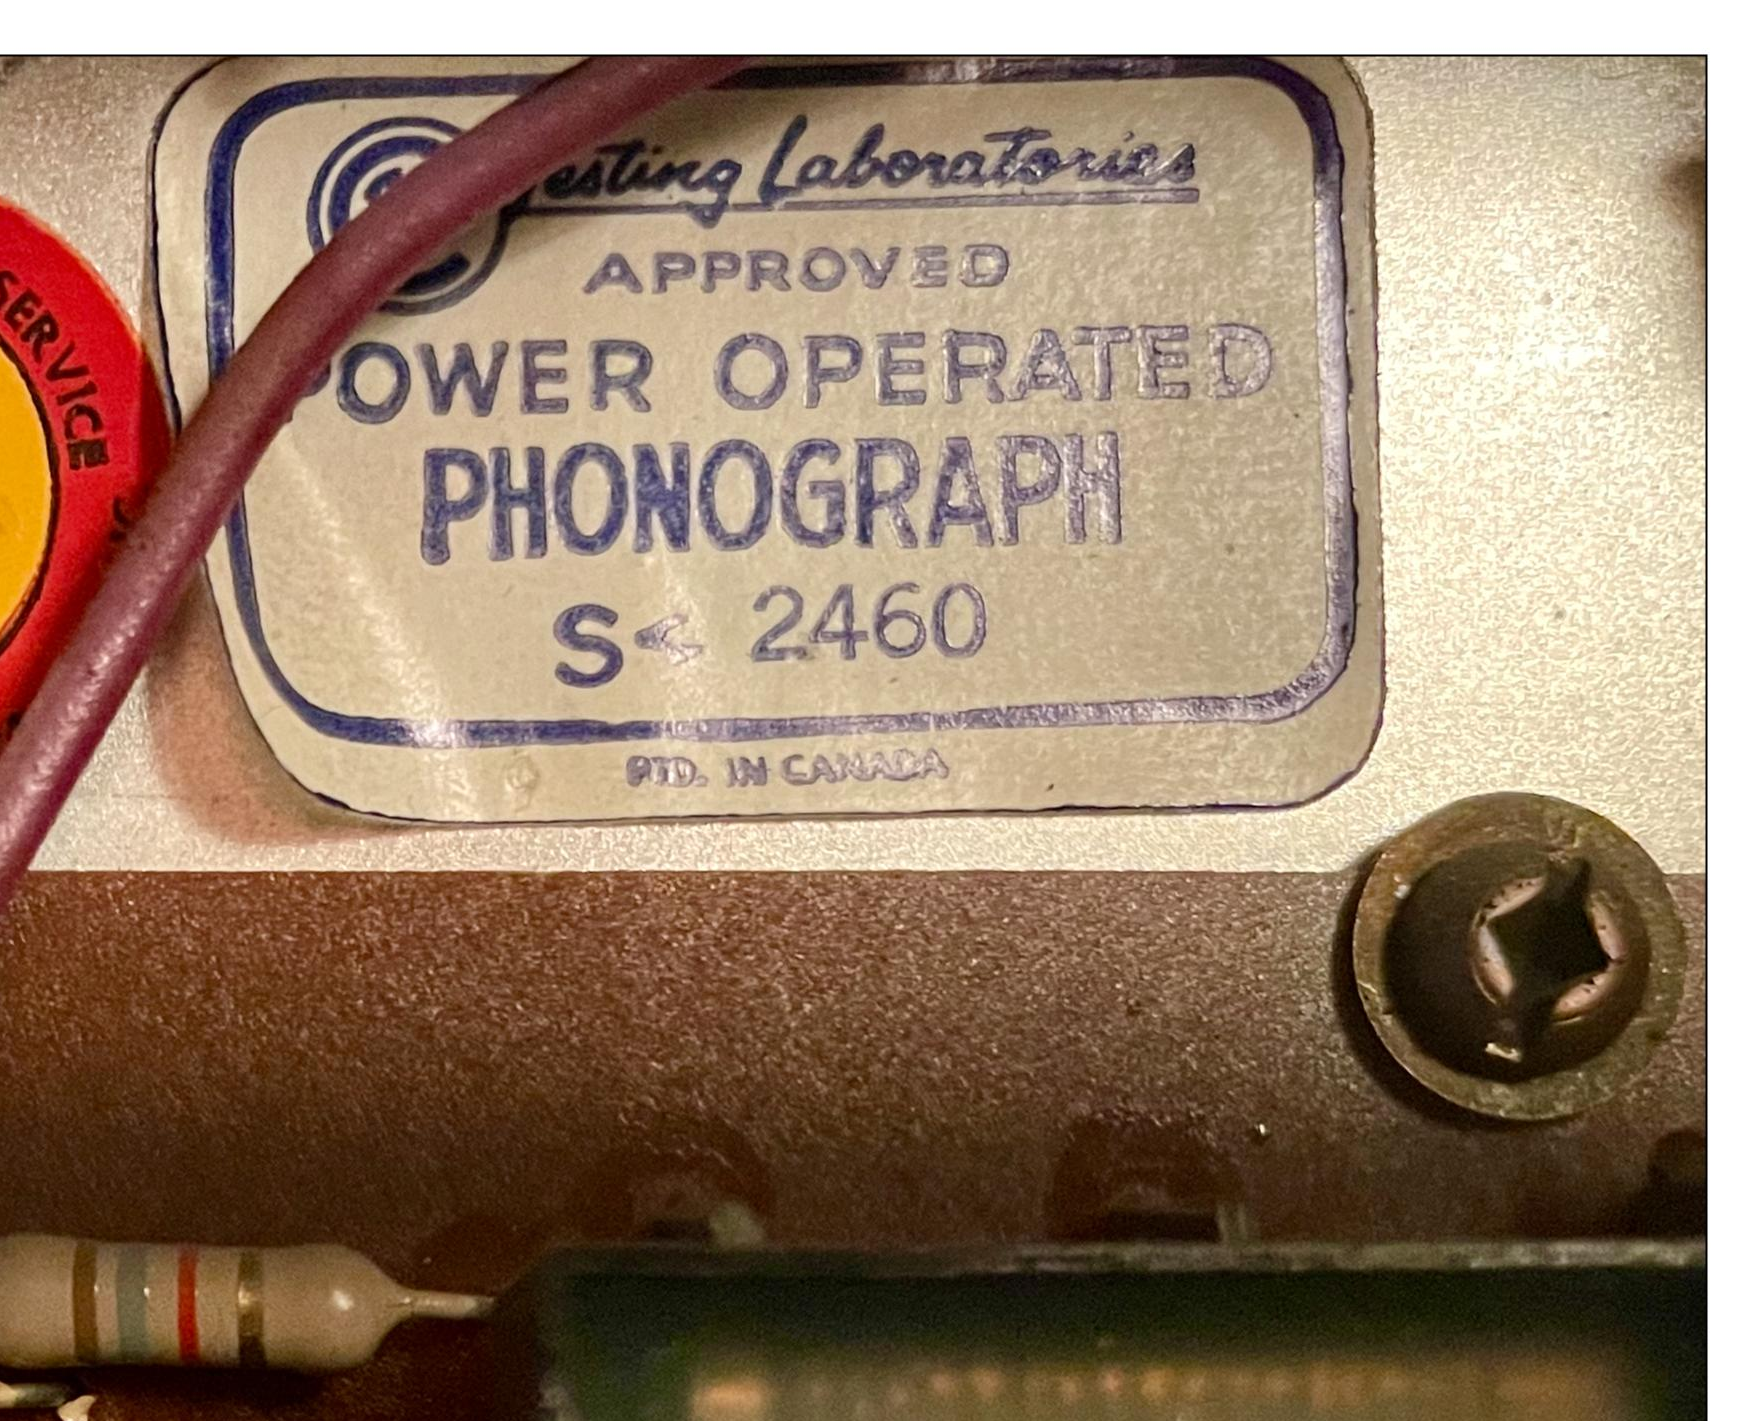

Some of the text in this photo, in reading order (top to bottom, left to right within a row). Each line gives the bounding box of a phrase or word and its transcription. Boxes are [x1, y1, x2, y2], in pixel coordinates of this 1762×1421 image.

[544, 138, 742, 228] esting
[758, 115, 1195, 208] Laboratories
[583, 243, 1010, 293] APPROVED
[304, 323, 1273, 425] OWER OPERATED
[421, 431, 1122, 565] PHONOGRAPH
[749, 581, 987, 662] 2460
[726, 756, 768, 788] IN
[781, 748, 949, 787] CANADA
